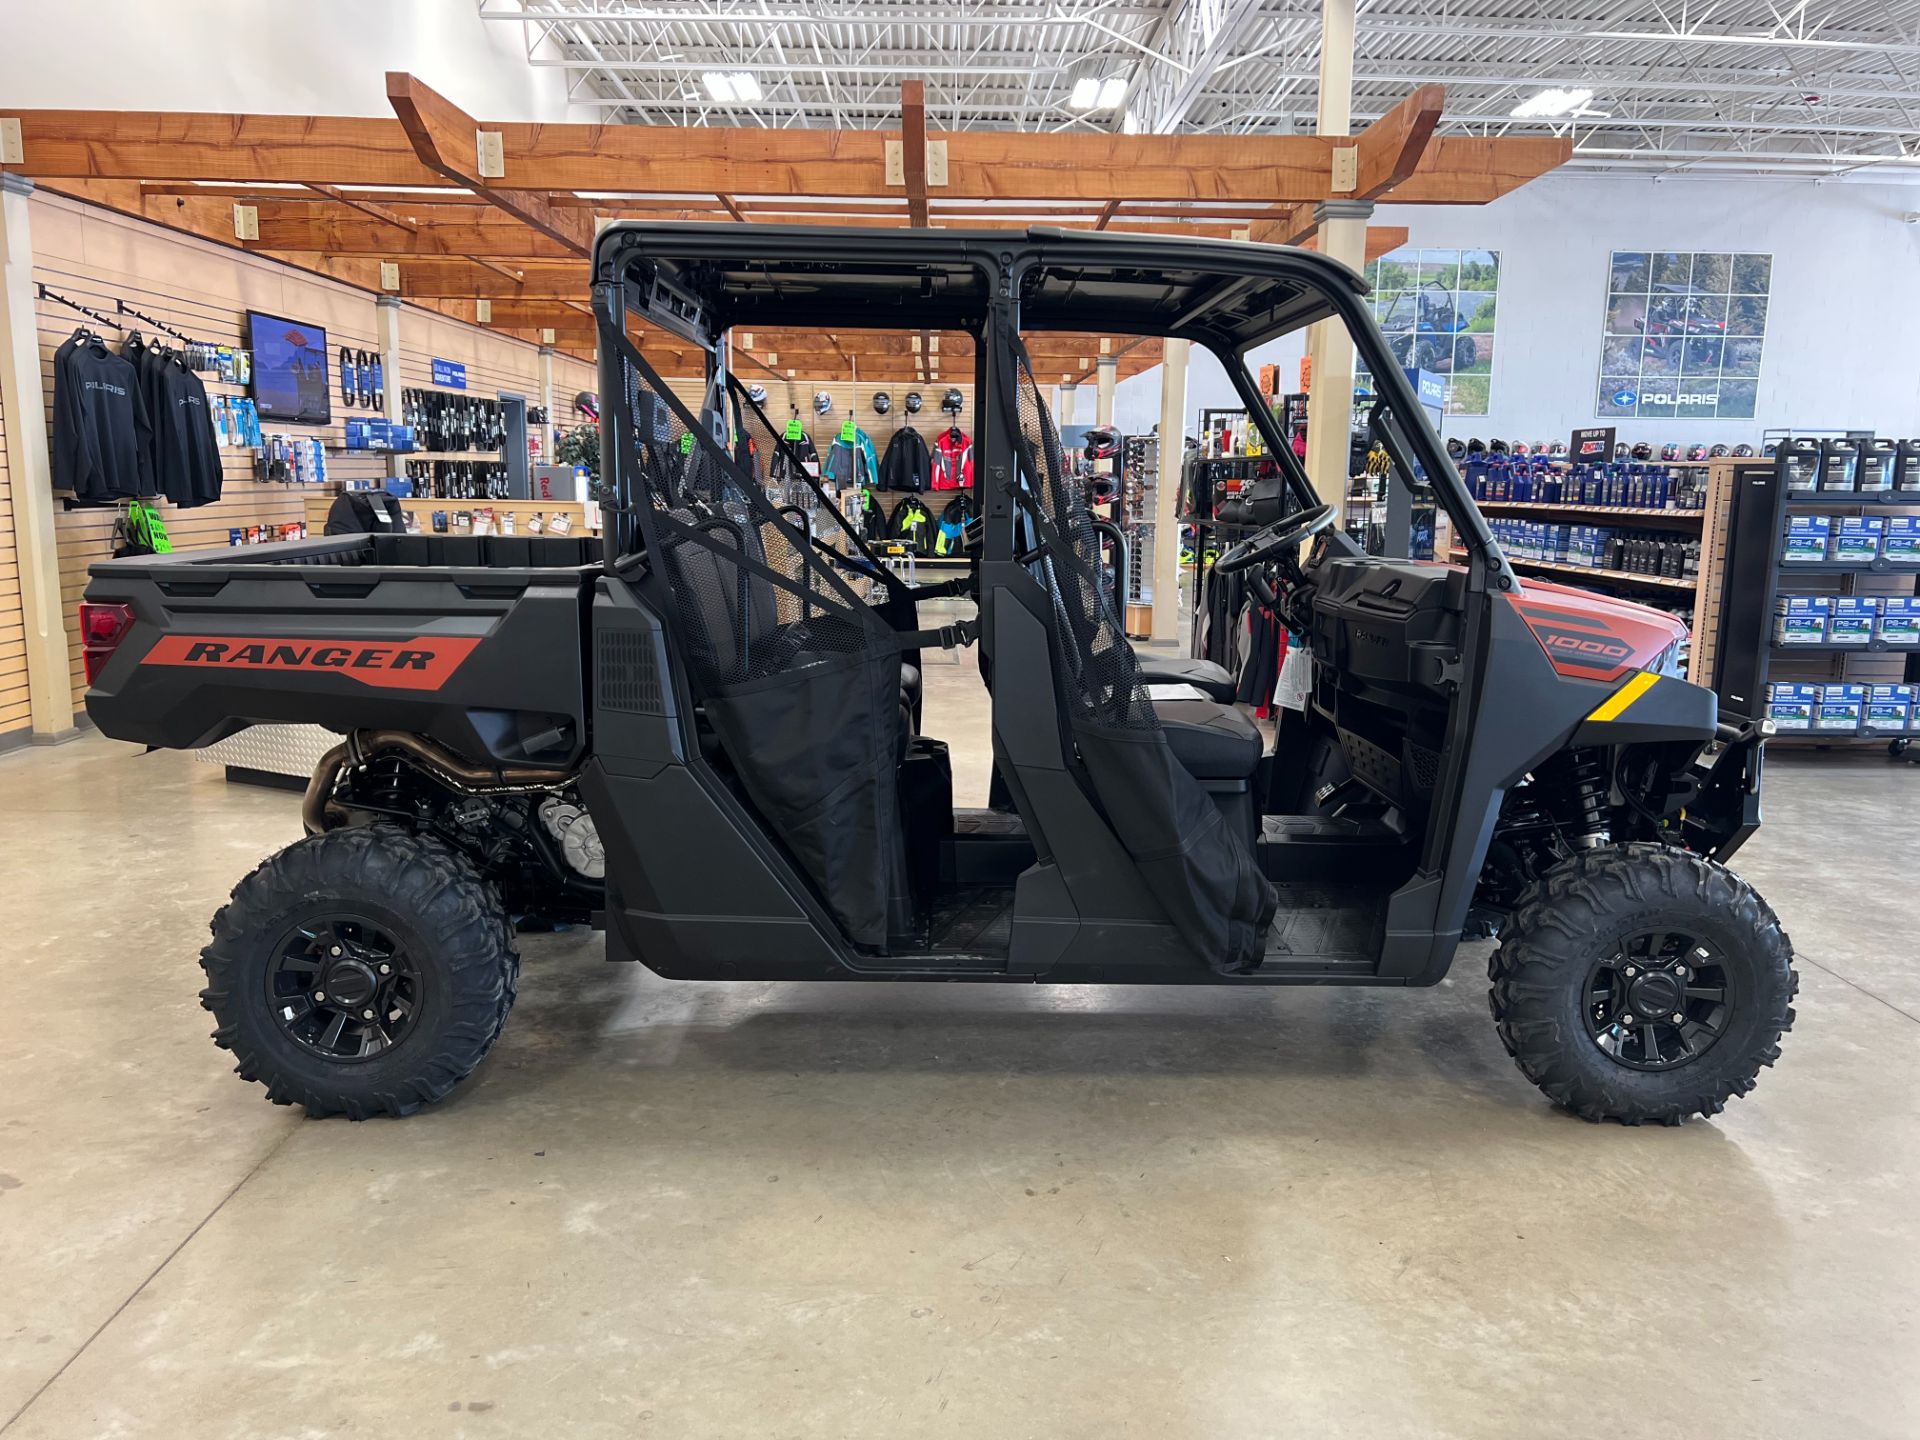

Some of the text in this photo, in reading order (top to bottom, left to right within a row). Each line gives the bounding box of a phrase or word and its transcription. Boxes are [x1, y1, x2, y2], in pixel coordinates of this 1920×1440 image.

[1422, 380, 1442, 398] POLARIS
[1641, 393, 1719, 405] POLARIS
[1545, 634, 1628, 657] 1000
[184, 642, 436, 670] RANGER
